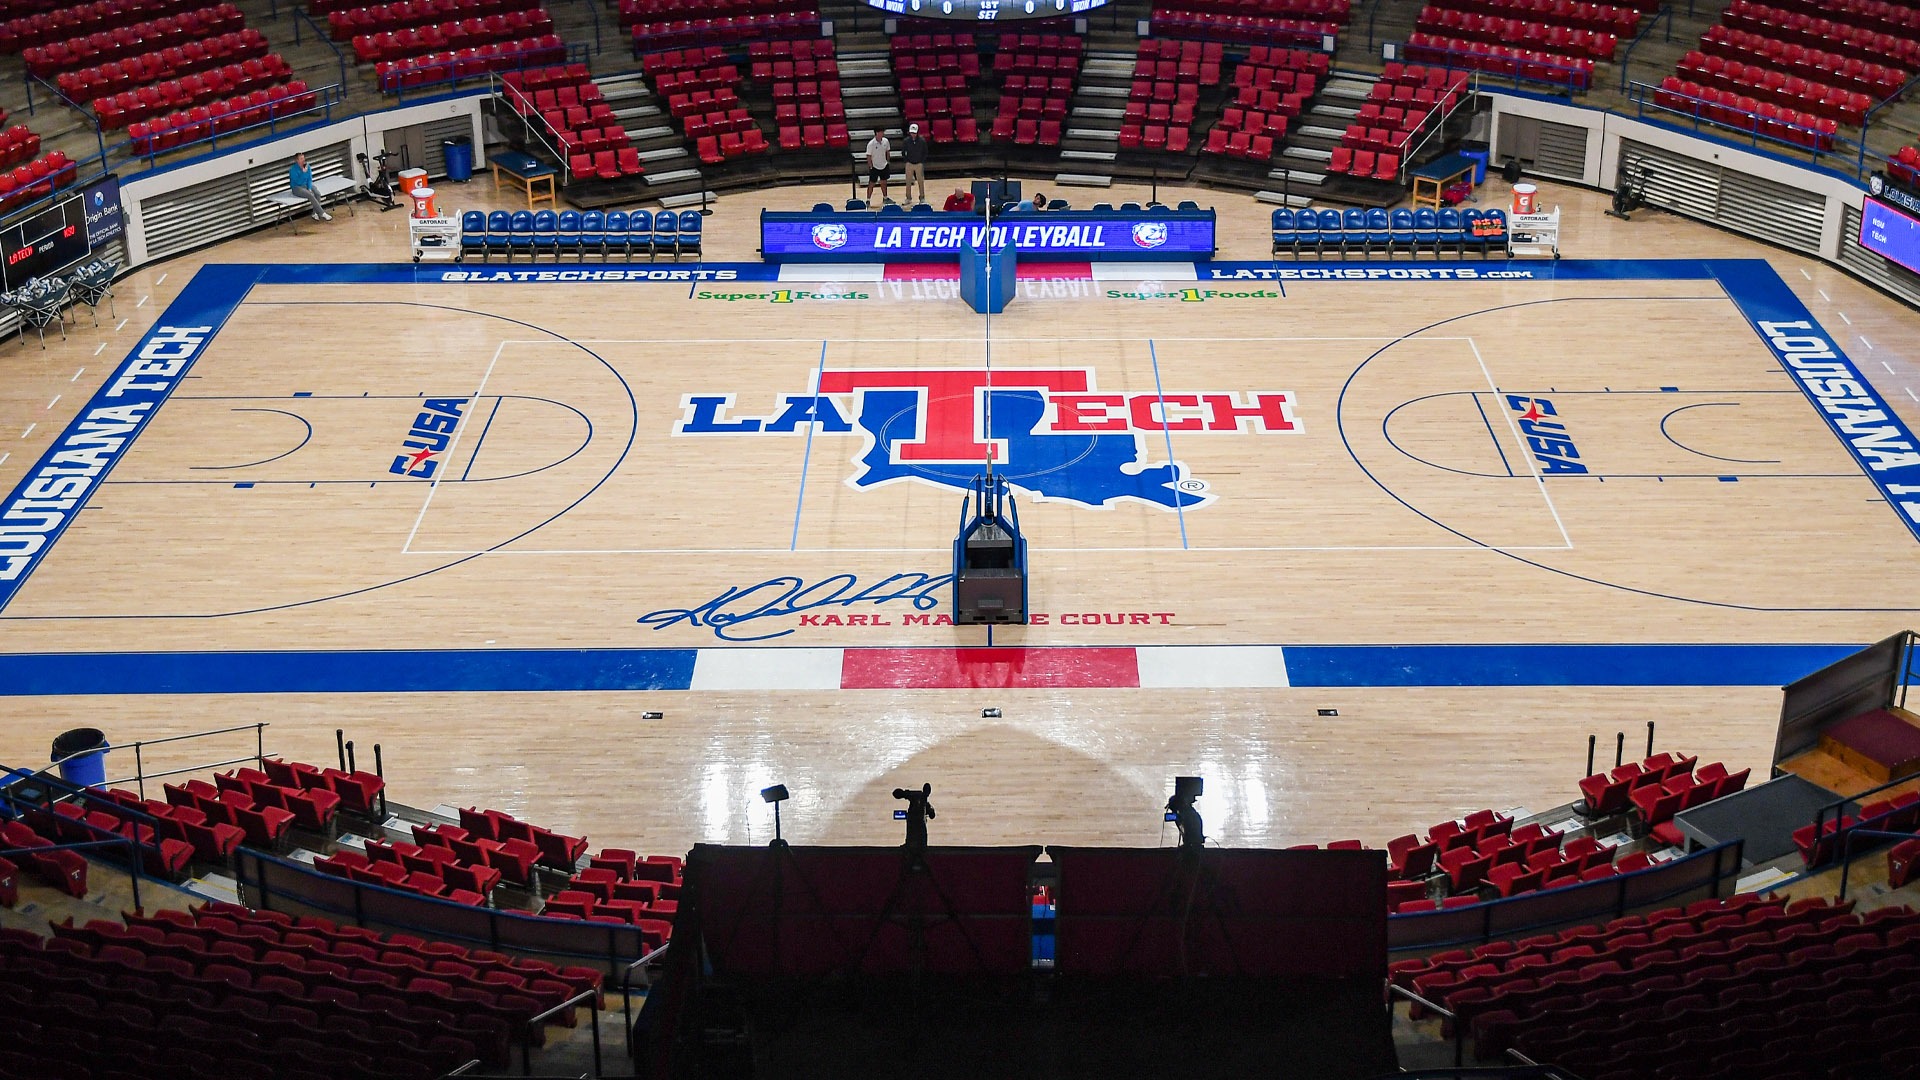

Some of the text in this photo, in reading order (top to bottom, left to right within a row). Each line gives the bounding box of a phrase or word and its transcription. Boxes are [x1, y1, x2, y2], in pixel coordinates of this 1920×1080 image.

[943, 0, 953, 14] 0
[980, 0, 999, 9] 1ST
[1025, 0, 1035, 14] 0
[977, 10, 998, 20] SET
[417, 200, 426, 210] G
[1519, 196, 1529, 206] G
[86, 203, 119, 225] Origin Bank
[874, 226, 1106, 248] LA TECH VOLLEYBALL
[1871, 230, 1887, 244] TECH
[38, 241, 55, 254] PERIOD
[441, 270, 738, 282] @LATECHSPORTS
[1210, 268, 1534, 280] LATECHSPORTS.COM
[105, 325, 214, 398] TECH
[1757, 320, 1920, 471] LOUISIANA
[680, 370, 1296, 461] LA TECH
[798, 612, 1176, 627] KARL MAE COURT
